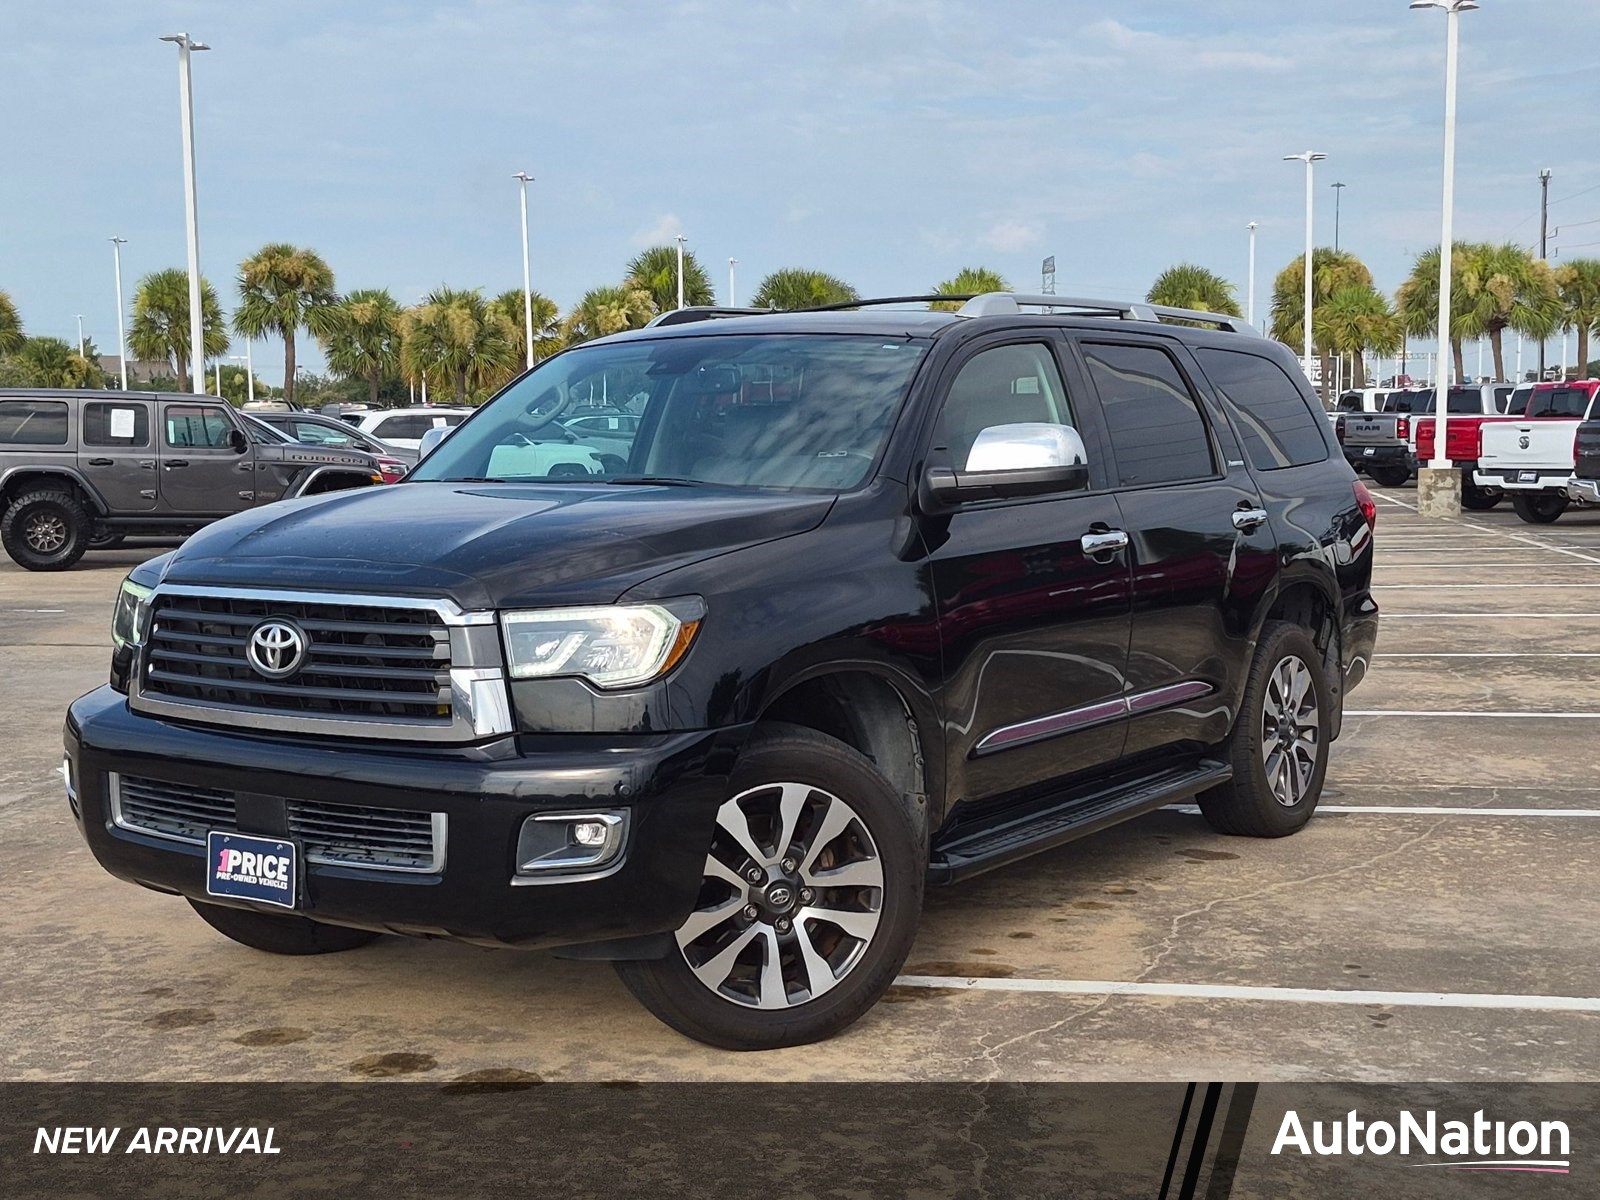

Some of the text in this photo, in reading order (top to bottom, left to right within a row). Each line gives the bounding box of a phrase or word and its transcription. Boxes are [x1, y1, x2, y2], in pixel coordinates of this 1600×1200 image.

[291, 454, 364, 464] RUBICON
[216, 871, 288, 890] PRE-OWNED VEHICLES
